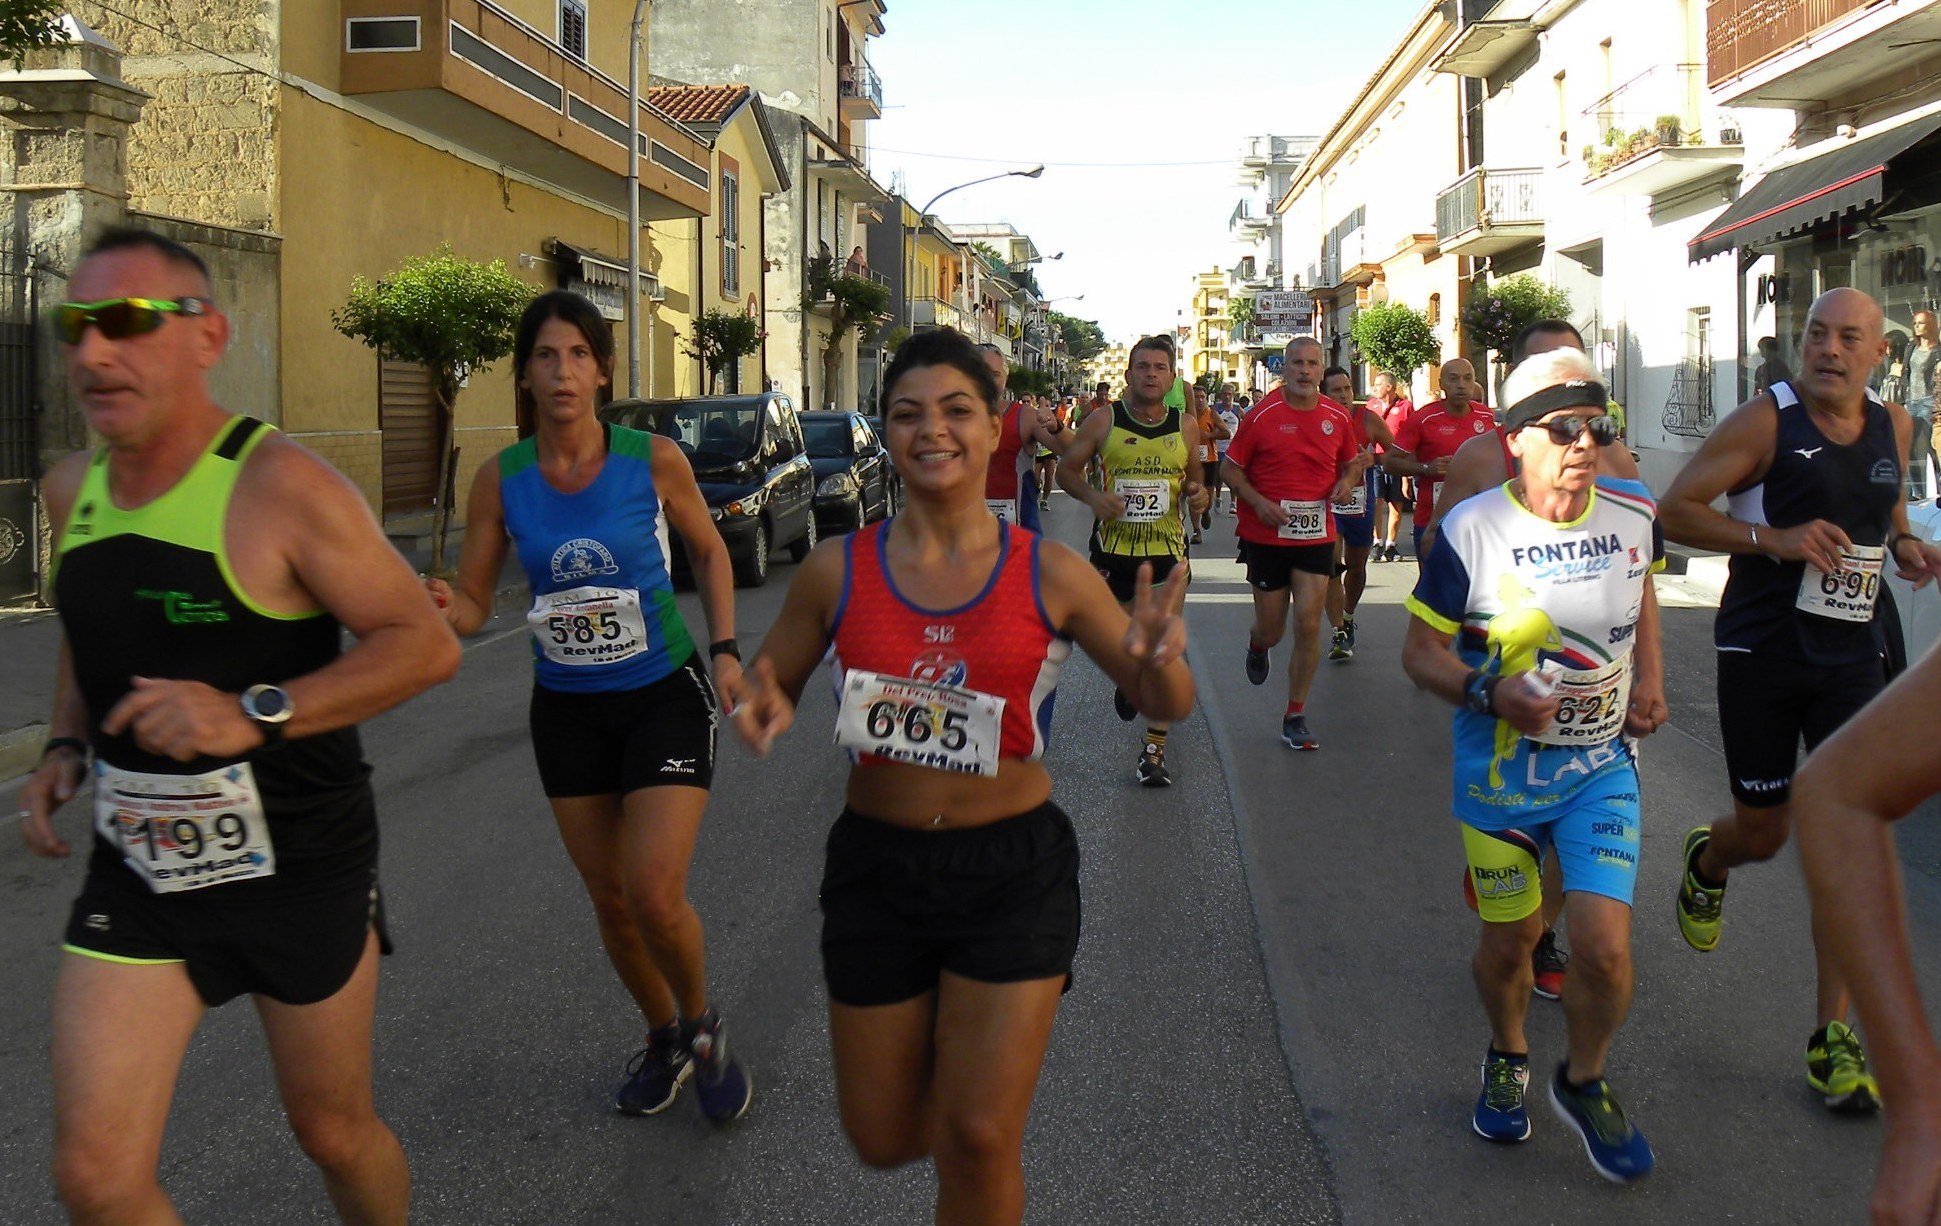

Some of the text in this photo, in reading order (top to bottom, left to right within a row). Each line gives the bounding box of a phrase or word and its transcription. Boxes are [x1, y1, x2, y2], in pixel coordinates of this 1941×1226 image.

[1124, 494, 1158, 510] 792
[1288, 514, 1319, 529] 208
[1512, 533, 1623, 567] FONTANA
[1535, 555, 1611, 579] Service
[1820, 569, 1878, 601] 690
[548, 611, 621, 644] 585
[563, 640, 638, 655] RevMad
[1555, 687, 1618, 725] 622
[867, 700, 969, 751] 665
[1526, 742, 1617, 787] LAB
[1591, 822, 1624, 837] SUPER
[1590, 846, 1635, 863] FONTANA
[1476, 873, 1528, 895] LAB
